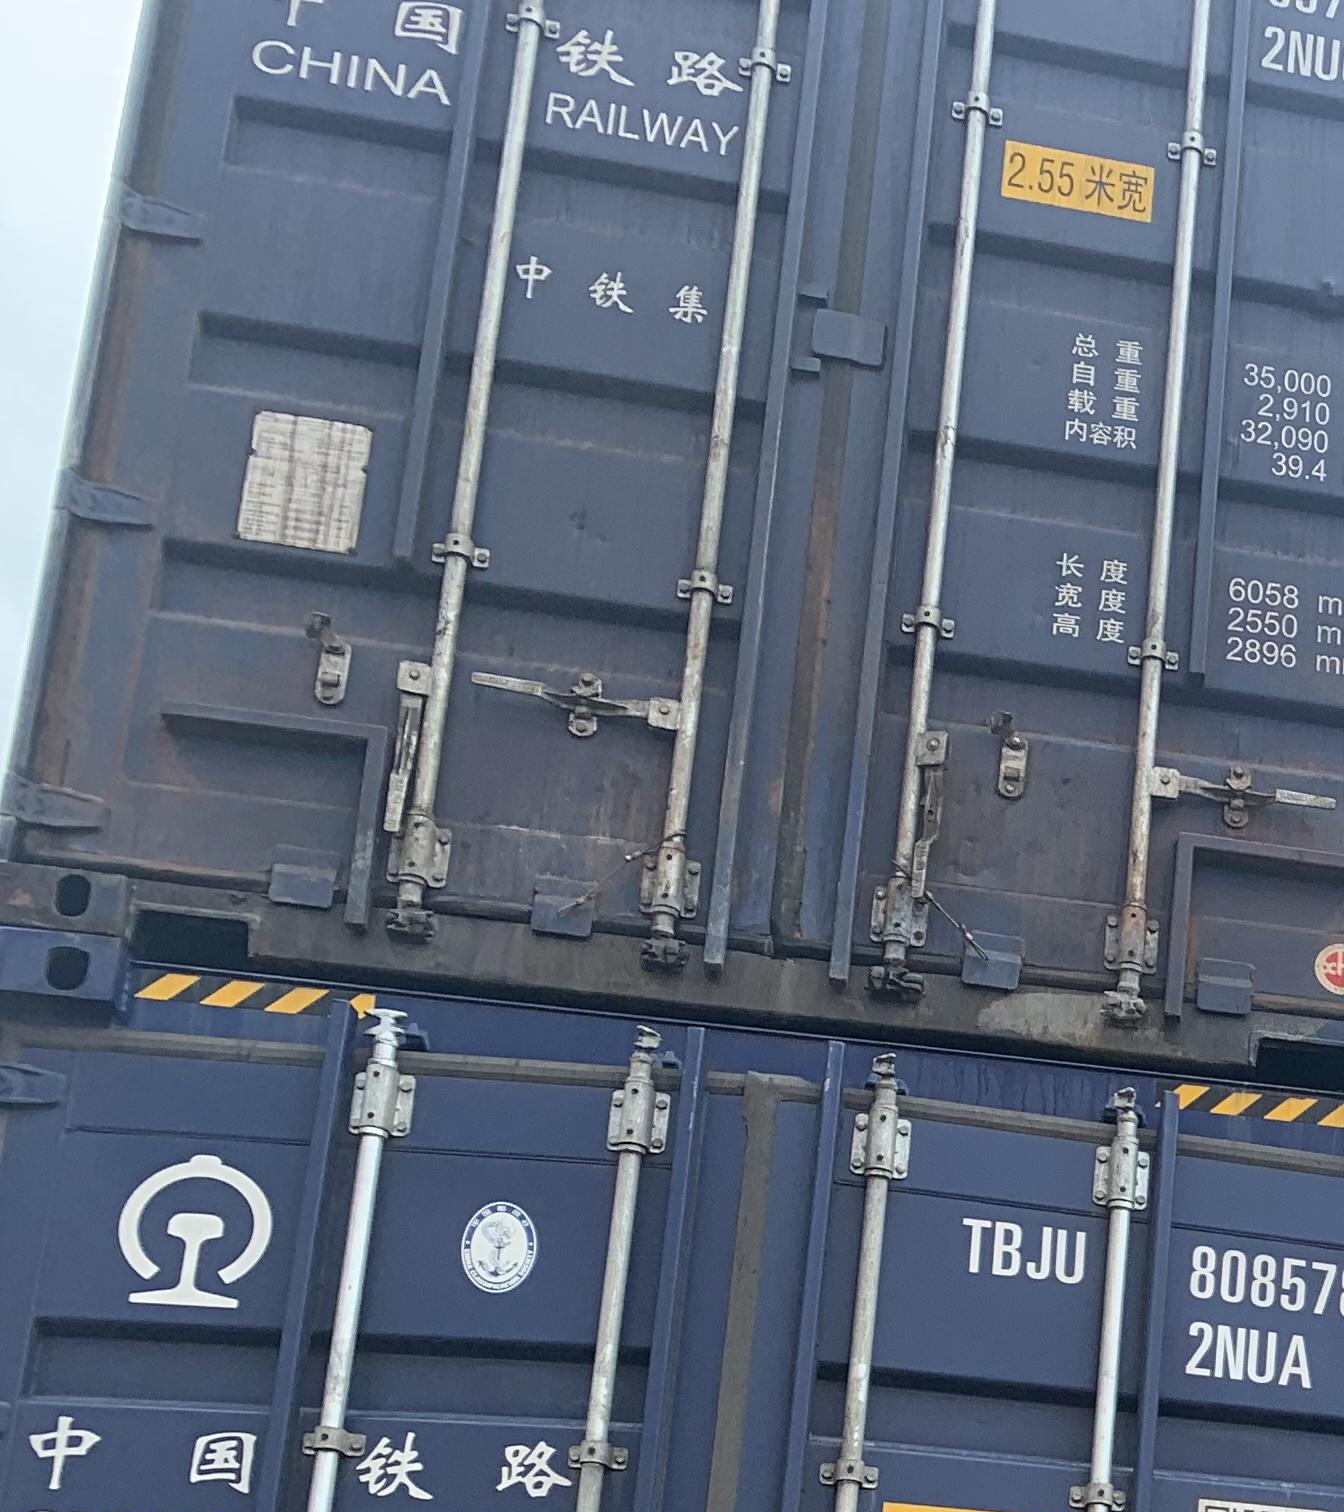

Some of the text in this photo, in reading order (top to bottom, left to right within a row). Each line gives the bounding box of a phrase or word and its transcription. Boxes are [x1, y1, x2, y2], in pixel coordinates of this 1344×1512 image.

[251, 39, 740, 156] CHINA RAILWAY
[515, 255, 708, 324] 中铁集
[1071, 333, 1143, 367] 总重
[1070, 361, 1142, 394] 自重
[1243, 363, 1332, 398] 35,000
[1067, 388, 1140, 422] 载重
[1257, 393, 1330, 426] 2,910
[1064, 418, 1137, 449] 内容积
[1240, 419, 1329, 454] 32,090
[1271, 452, 1327, 482] 39.4
[1056, 552, 1128, 585] 长度
[1054, 582, 1126, 614] 宽度
[1229, 577, 1299, 609] 6058
[1052, 612, 1124, 644] 高度
[1227, 607, 1298, 639] 2550
[1225, 636, 1297, 668] 2896
[962, 1217, 1087, 1284] TBJU
[1185, 1321, 1312, 1389] 2NUA
